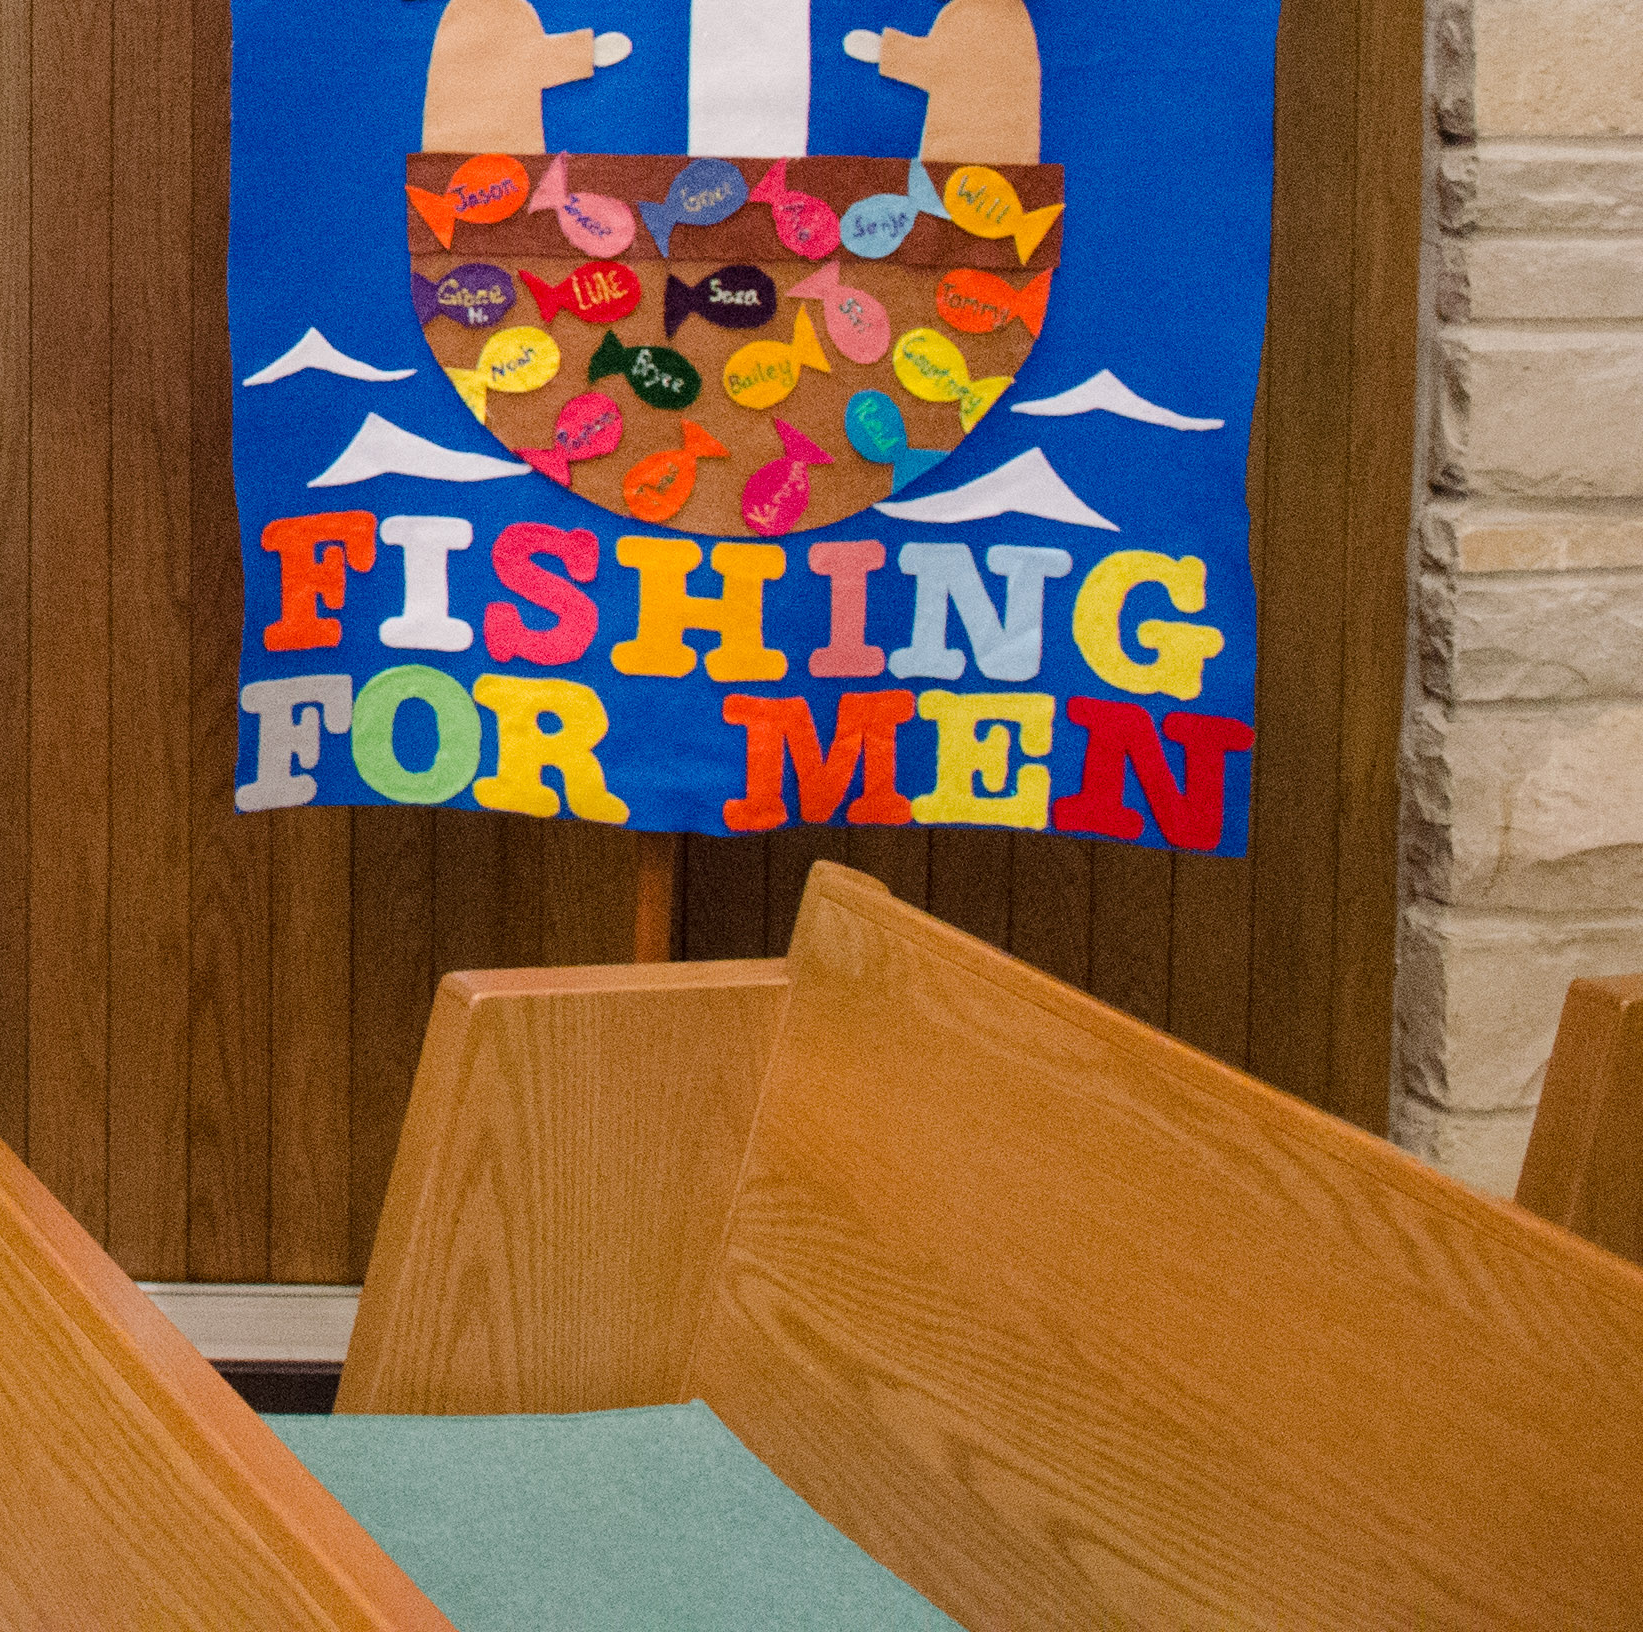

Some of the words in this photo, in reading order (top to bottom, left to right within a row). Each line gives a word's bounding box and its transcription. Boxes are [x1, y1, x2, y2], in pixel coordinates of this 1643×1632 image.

[450, 177, 519, 213] Jason
[956, 176, 1011, 225] Will
[728, 360, 794, 396] Bailey
[260, 509, 1225, 700] FISHING
[235, 664, 630, 824] FOR
[721, 688, 1255, 851] MEN
